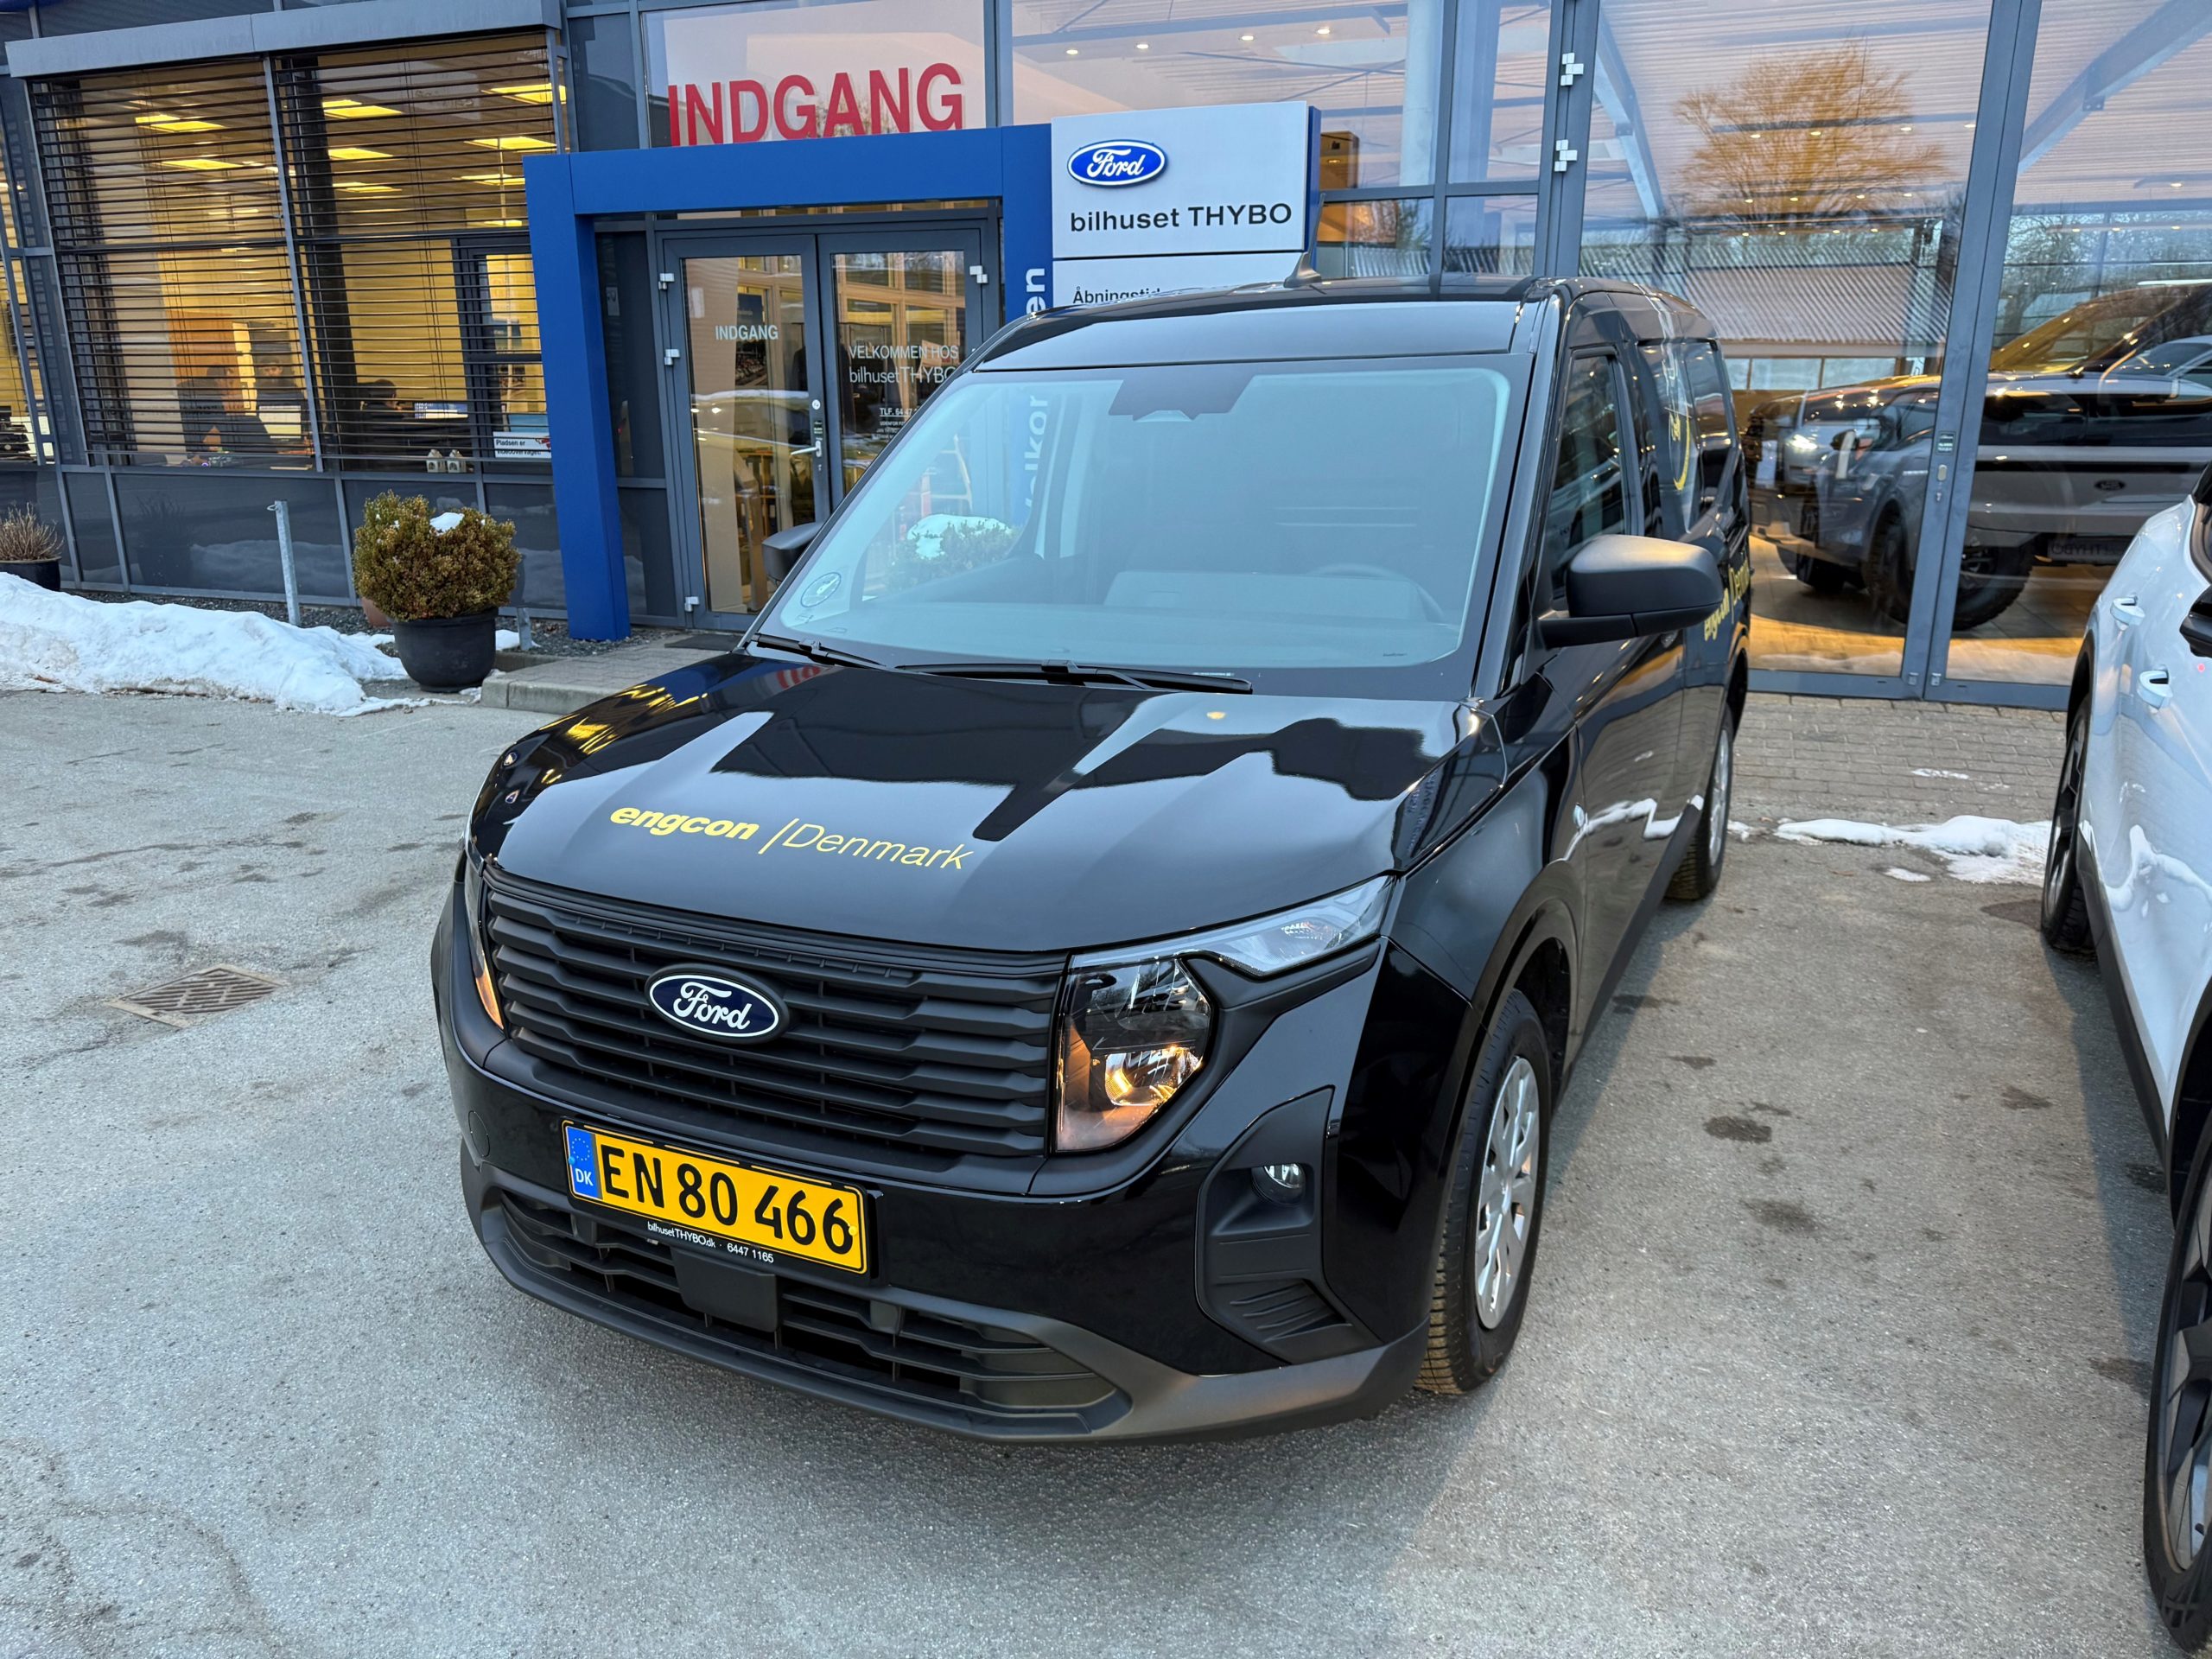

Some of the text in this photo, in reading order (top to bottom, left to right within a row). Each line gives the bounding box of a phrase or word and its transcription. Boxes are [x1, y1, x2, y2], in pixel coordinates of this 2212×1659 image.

[667, 62, 963, 147] INDGANG
[1086, 148, 1147, 178] Ford
[1071, 202, 1292, 232] bilhuset THYBO
[715, 325, 779, 340] INDGANG
[849, 345, 959, 359] VELKOMMEN HOS
[610, 806, 760, 840] engcon
[672, 982, 753, 1030] Ford
[575, 1144, 854, 1255] DK EN 80 466
[727, 1242, 749, 1257] 6447
[752, 1249, 774, 1263] 1165
